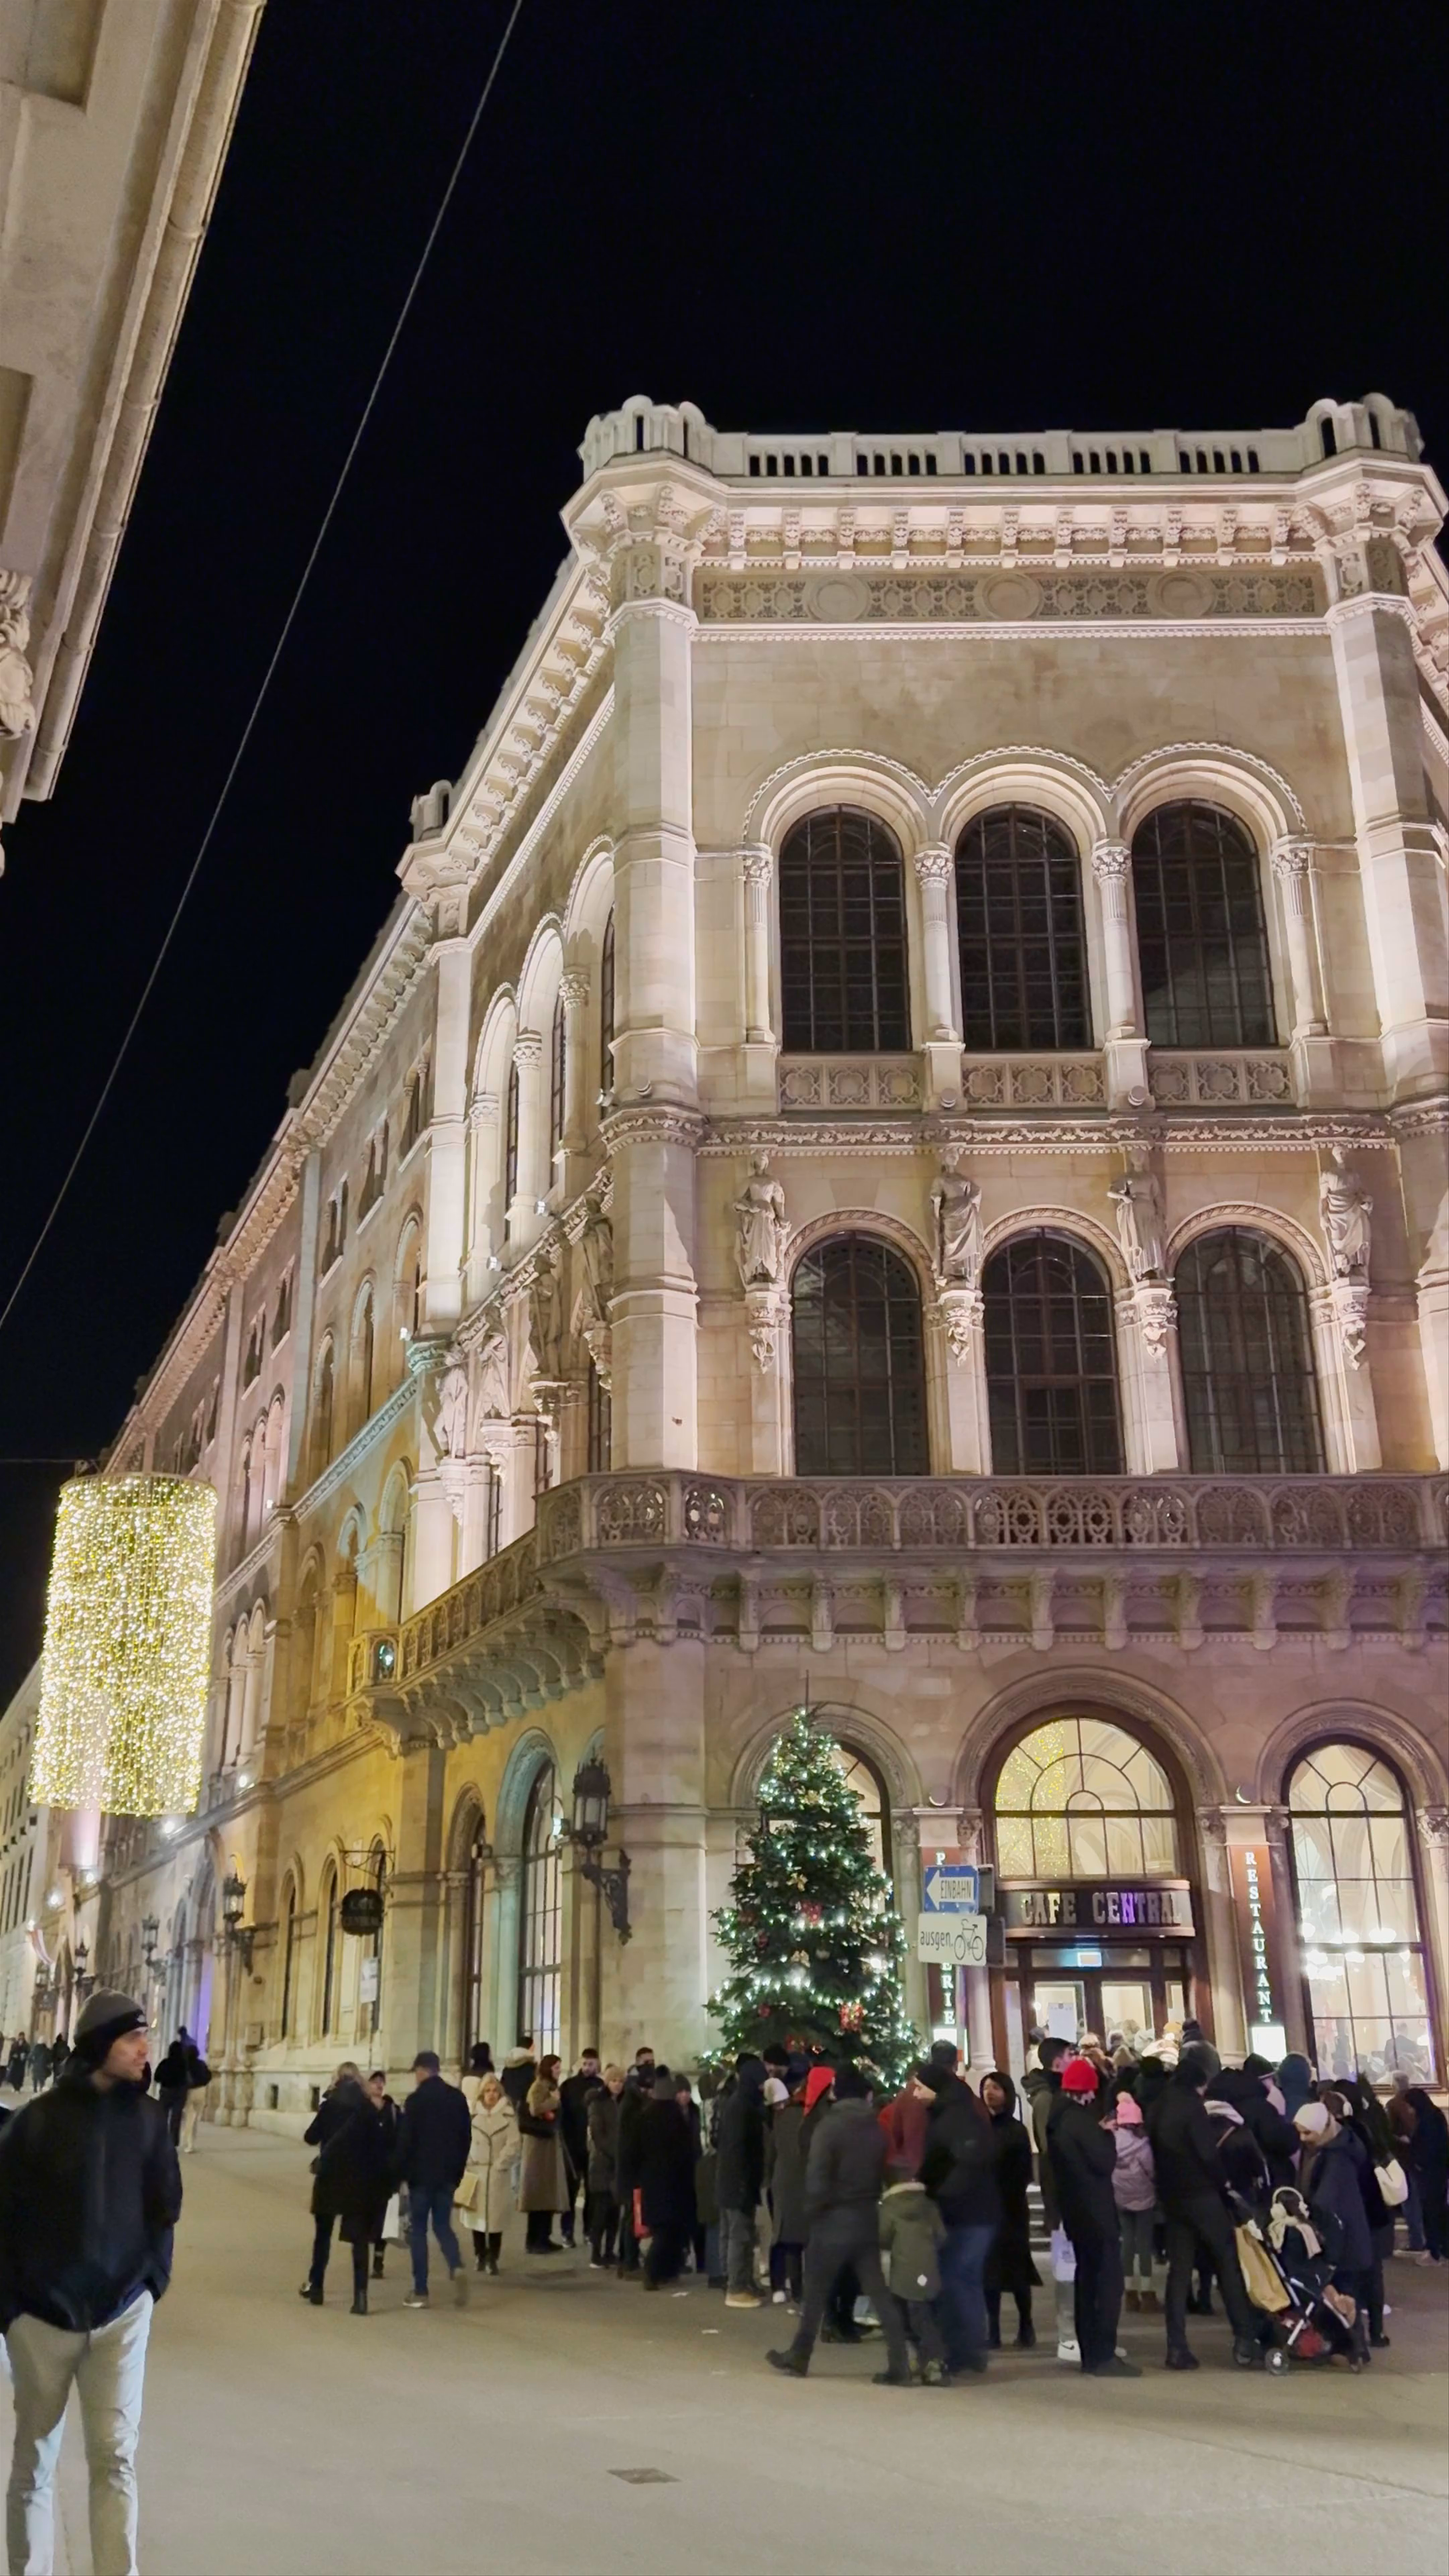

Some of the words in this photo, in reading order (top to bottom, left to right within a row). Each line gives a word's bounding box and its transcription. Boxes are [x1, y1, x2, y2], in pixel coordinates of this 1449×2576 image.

[940, 1880, 971, 1899] EINBAHN
[1092, 1892, 1182, 1924] CENTRAL
[920, 1931, 953, 1951] ausgen.
[1245, 1852, 1271, 2023] RESTAURANT
